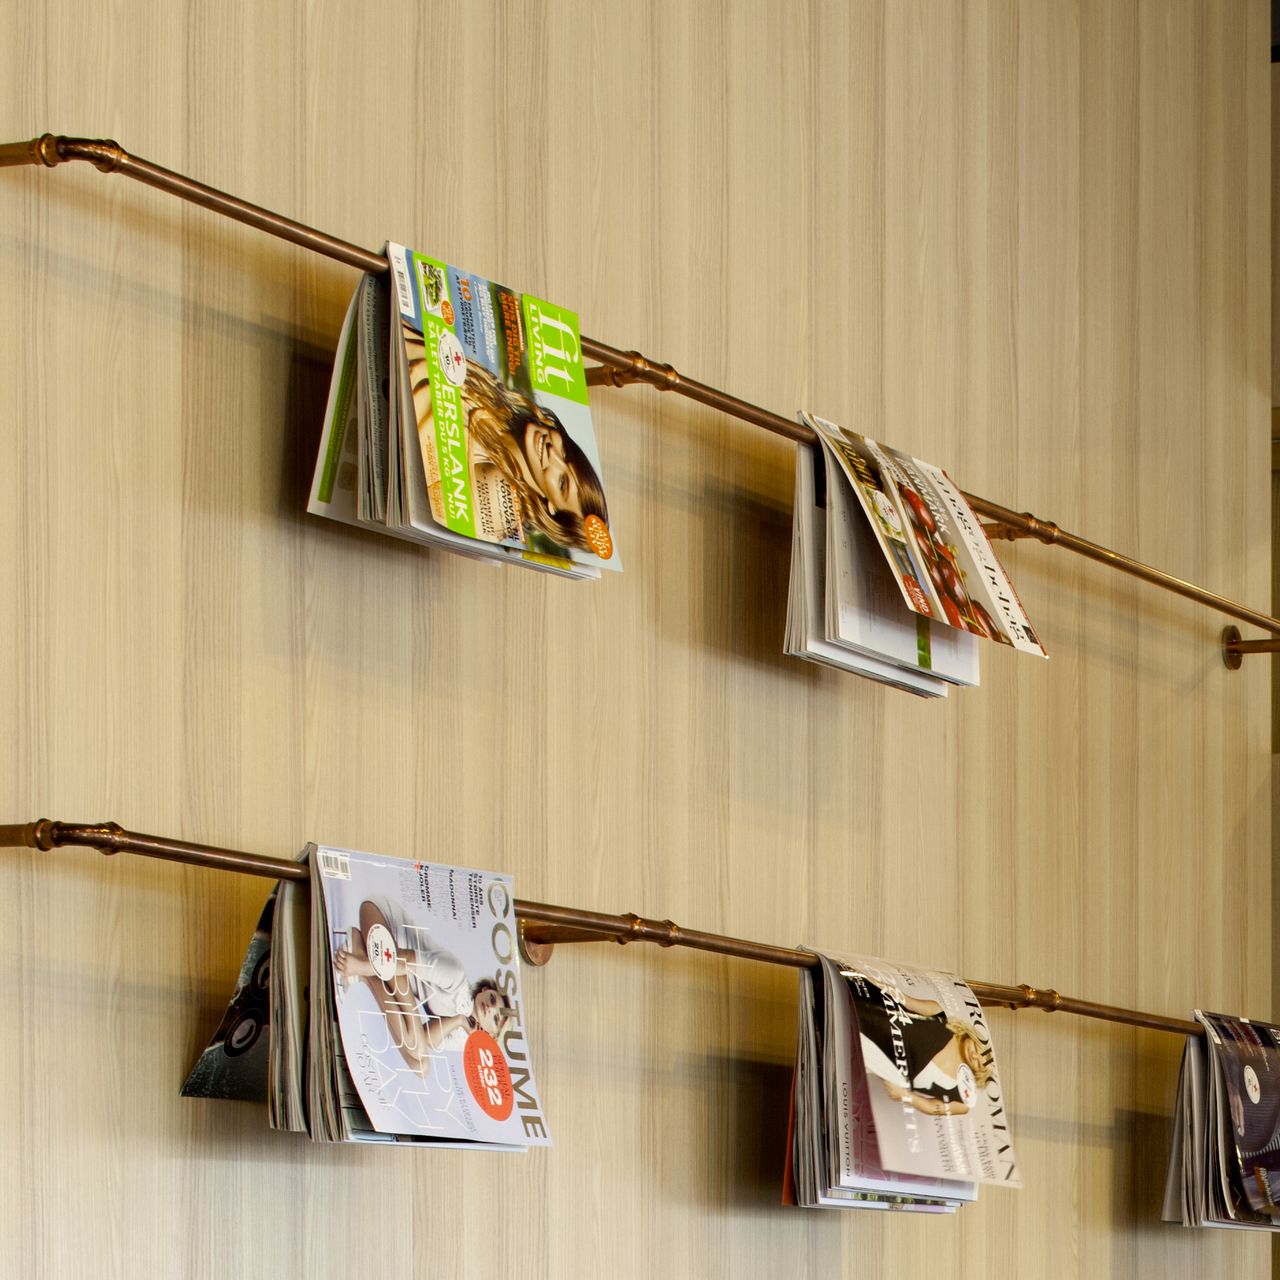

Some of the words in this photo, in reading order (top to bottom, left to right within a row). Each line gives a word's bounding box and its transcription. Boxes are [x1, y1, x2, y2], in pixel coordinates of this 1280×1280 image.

[426, 319, 436, 340] SÅ
[459, 276, 473, 303] 10
[467, 302, 477, 354] FANTASTISKE
[500, 291, 510, 326] MERE
[507, 294, 515, 321] SPIS
[428, 341, 440, 369] LET
[510, 323, 519, 346] DIG
[529, 302, 545, 385] LIVING
[536, 306, 581, 392] fit
[513, 351, 521, 367] TIL
[433, 372, 443, 417] TABER
[437, 420, 447, 442] DU
[440, 445, 447, 453] 5
[442, 457, 451, 477] KG
[445, 491, 456, 519] NU!
[499, 478, 514, 539] YOYOVÆGT
[505, 483, 516, 523] FARVEL
[512, 527, 520, 542] TIL
[893, 456, 952, 536] DANMARK
[588, 527, 596, 545] LIV
[591, 518, 604, 558] SUNDE
[423, 865, 432, 912] DRØMME-
[449, 869, 457, 919] MADONNA!
[468, 873, 476, 928] TENDENSER
[400, 923, 468, 1131] HAPPY
[491, 877, 547, 1139] COSTUME
[476, 1064, 486, 1088] sider
[478, 1047, 503, 1106] 232
[844, 1123, 852, 1177] VUITTON
